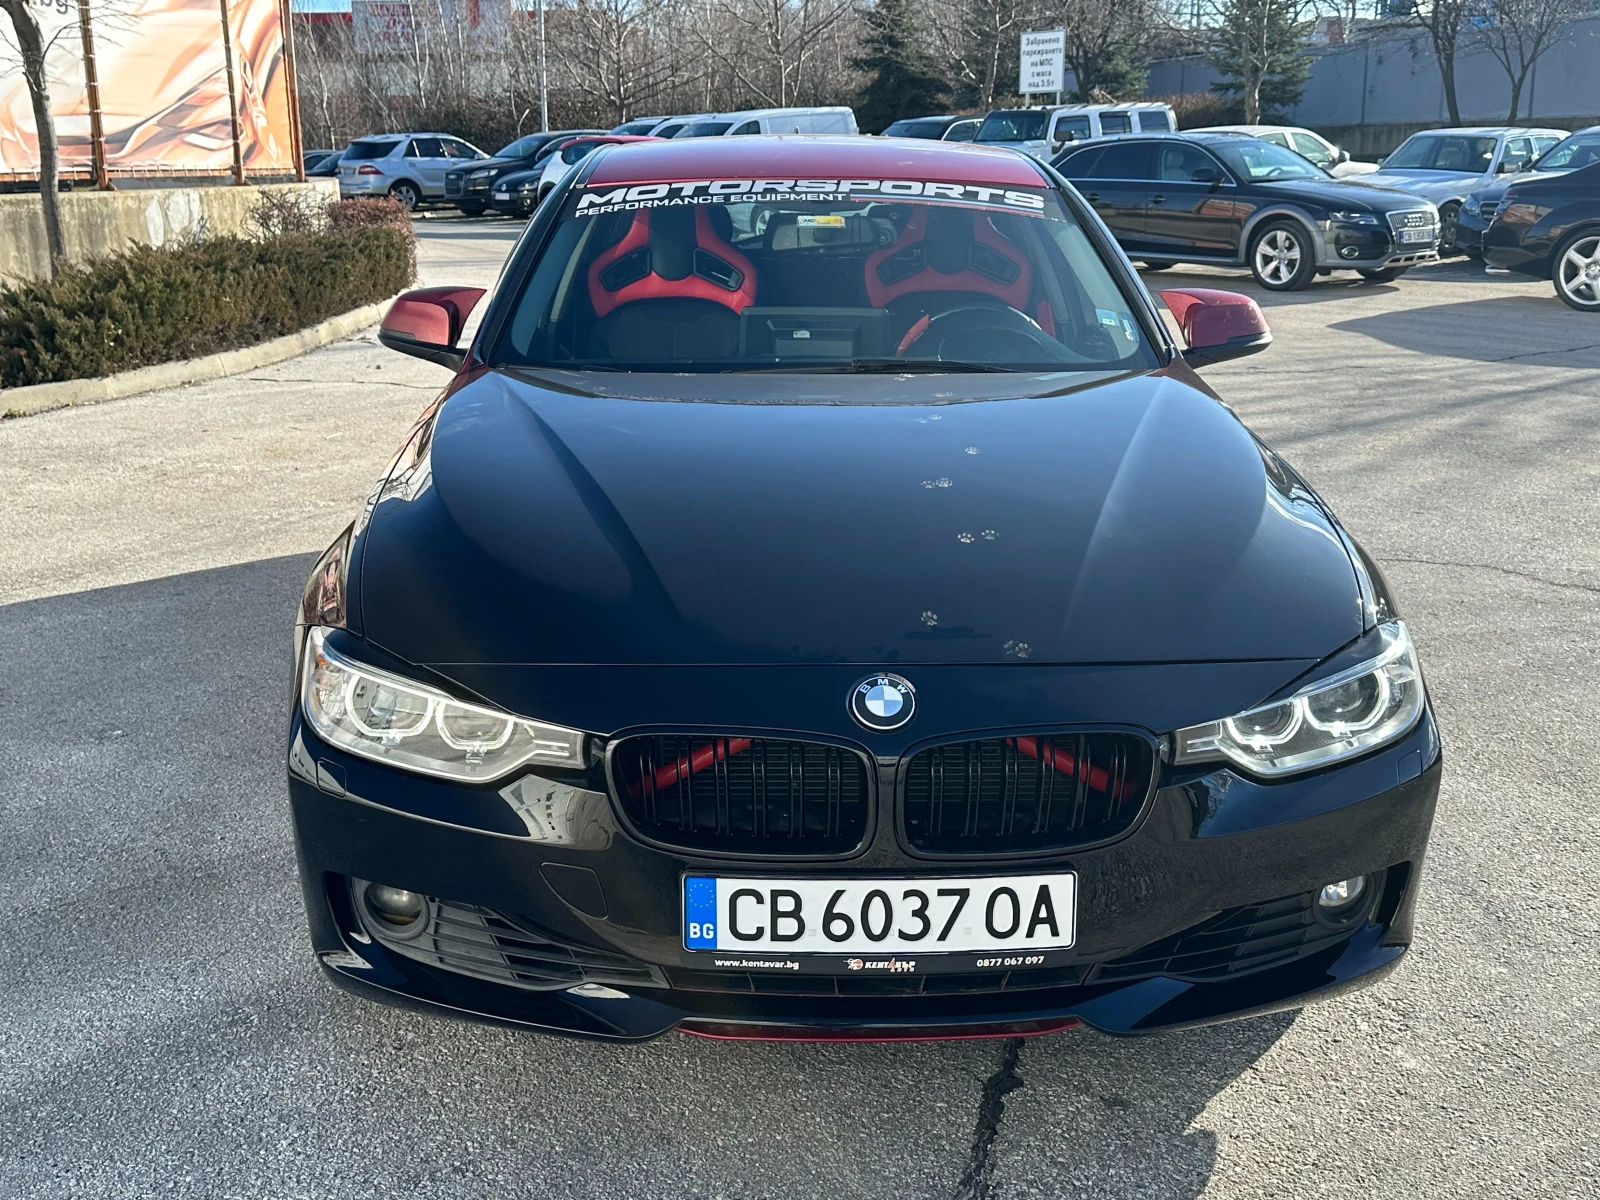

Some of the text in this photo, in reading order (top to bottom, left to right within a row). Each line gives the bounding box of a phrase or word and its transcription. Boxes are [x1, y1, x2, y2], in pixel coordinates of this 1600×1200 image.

[1025, 37, 1060, 46] Забранено
[1022, 47, 1063, 57] паркирането
[1039, 58, 1053, 66] МПС
[576, 179, 1045, 209] MOTORSPORTS
[575, 192, 847, 218] PERFORMANCE EQUIPMENT
[859, 678, 908, 694] BMW
[728, 884, 1060, 943] CB 6037 OA
[689, 922, 715, 939] BG
[714, 958, 800, 970] www.kentavar.bg
[976, 955, 1045, 967] 0877 067 097
